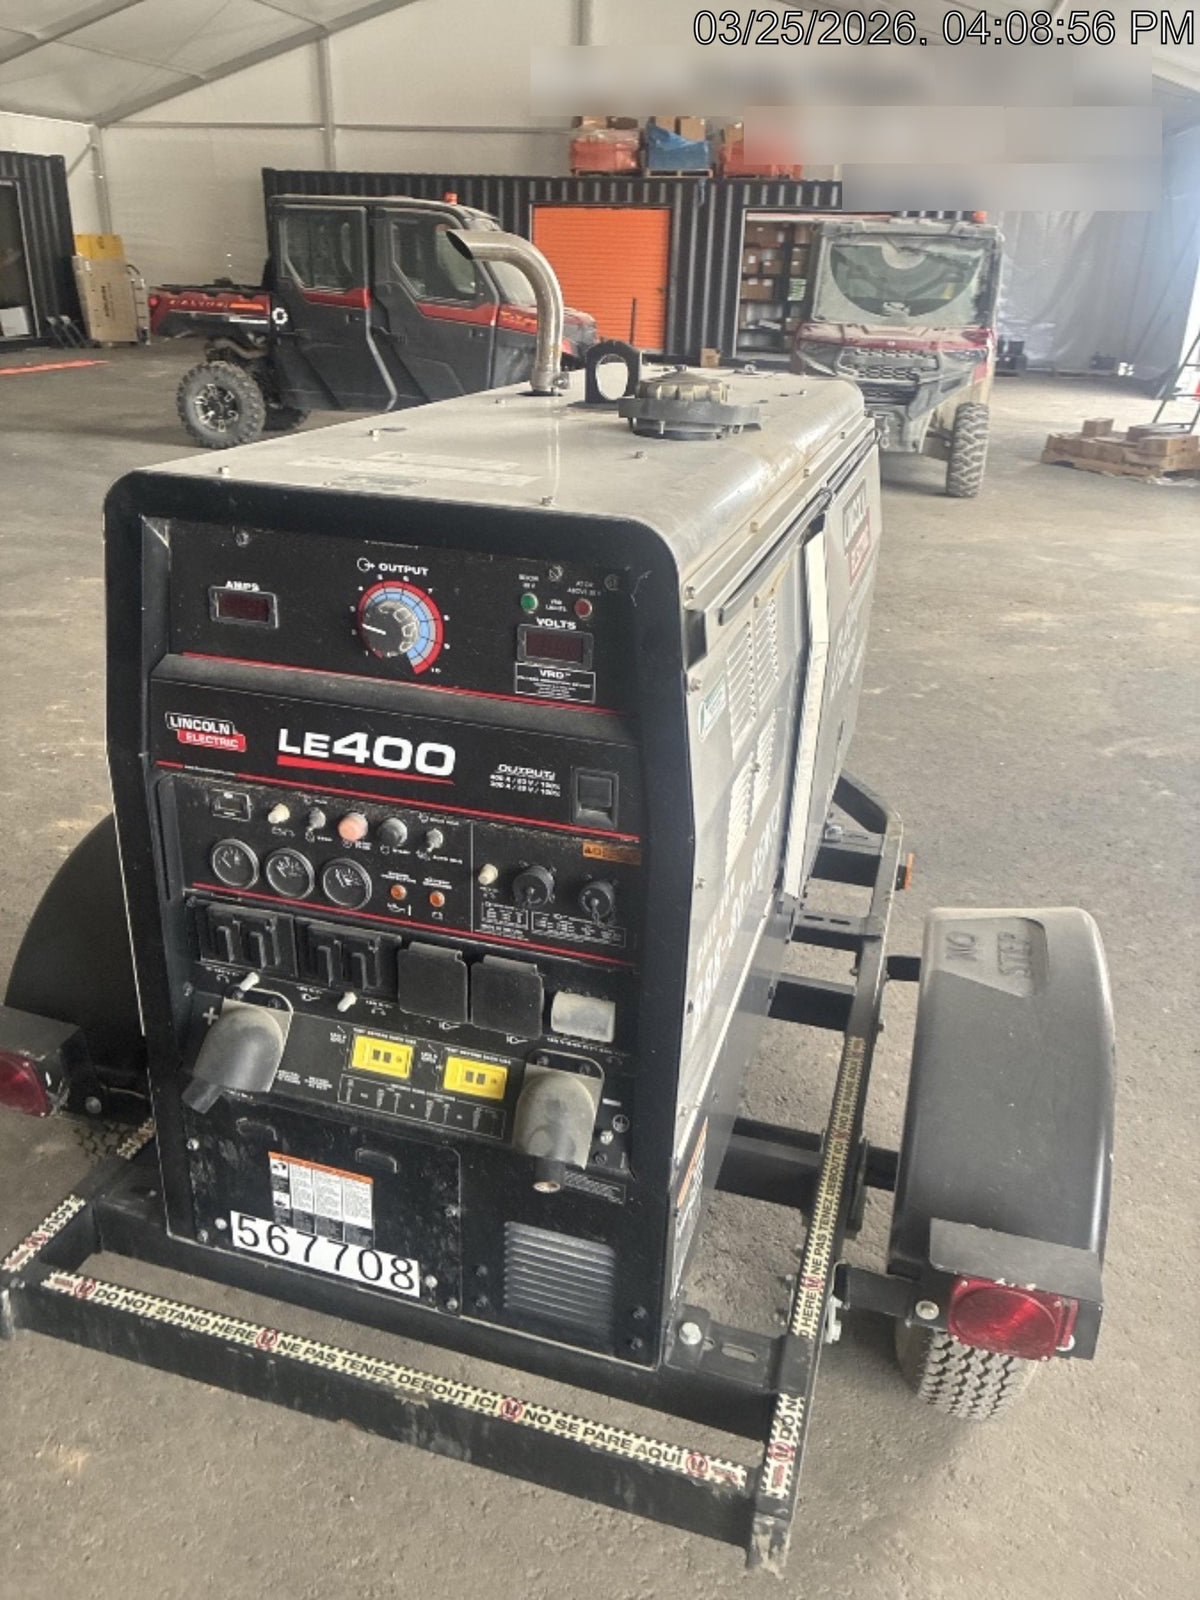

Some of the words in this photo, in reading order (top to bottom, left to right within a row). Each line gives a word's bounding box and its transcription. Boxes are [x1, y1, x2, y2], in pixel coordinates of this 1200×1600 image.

[378, 562, 429, 576] OUTPUT
[225, 579, 260, 592] AMPS
[536, 616, 577, 630] VOLTS
[170, 714, 231, 735] LINCOLN
[184, 731, 239, 749] ELECTRIC
[278, 728, 456, 776] LE400
[237, 1212, 415, 1291] 567708
[94, 1287, 119, 1301] DO
[120, 1295, 156, 1311] NOT
[156, 1306, 210, 1327] STAND
[211, 1319, 257, 1340] HERE
[277, 1340, 302, 1353] NE
[303, 1347, 338, 1363] PAS
[342, 1357, 397, 1380] TENEZ
[397, 1373, 472, 1401] DEBOUT
[473, 1394, 499, 1409] ICI
[523, 1408, 551, 1425] NO
[554, 1418, 579, 1434] SE
[582, 1427, 633, 1450] PARE
